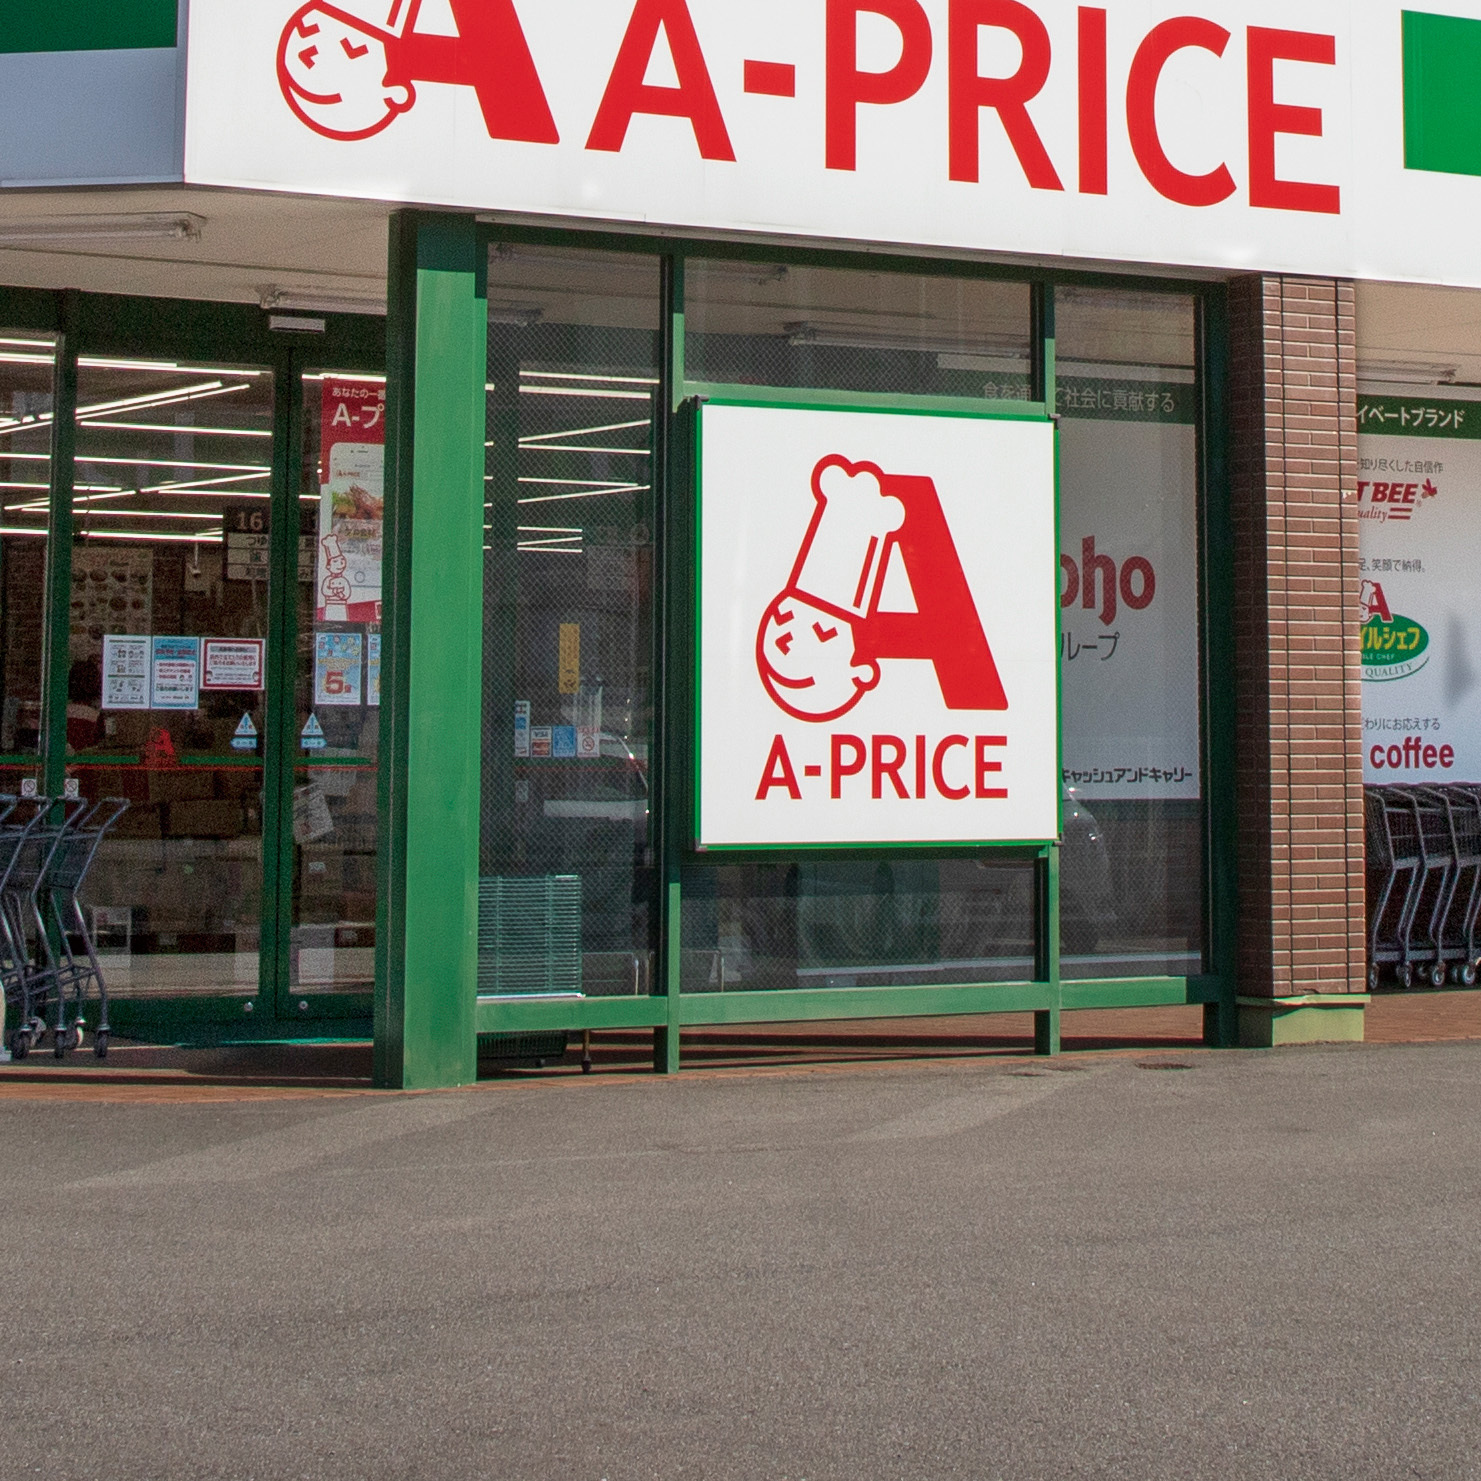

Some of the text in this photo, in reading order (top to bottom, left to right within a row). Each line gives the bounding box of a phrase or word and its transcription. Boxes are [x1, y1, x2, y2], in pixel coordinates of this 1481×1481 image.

[1358, 458, 1444, 474] 知り尽くした自信作
[1371, 481, 1419, 504] BEE
[237, 511, 264, 531] 16
[1061, 631, 1120, 663] ループ
[1365, 662, 1413, 679] QUALITY
[1370, 736, 1455, 769] coffee
[755, 733, 1009, 801] A-PRICE
